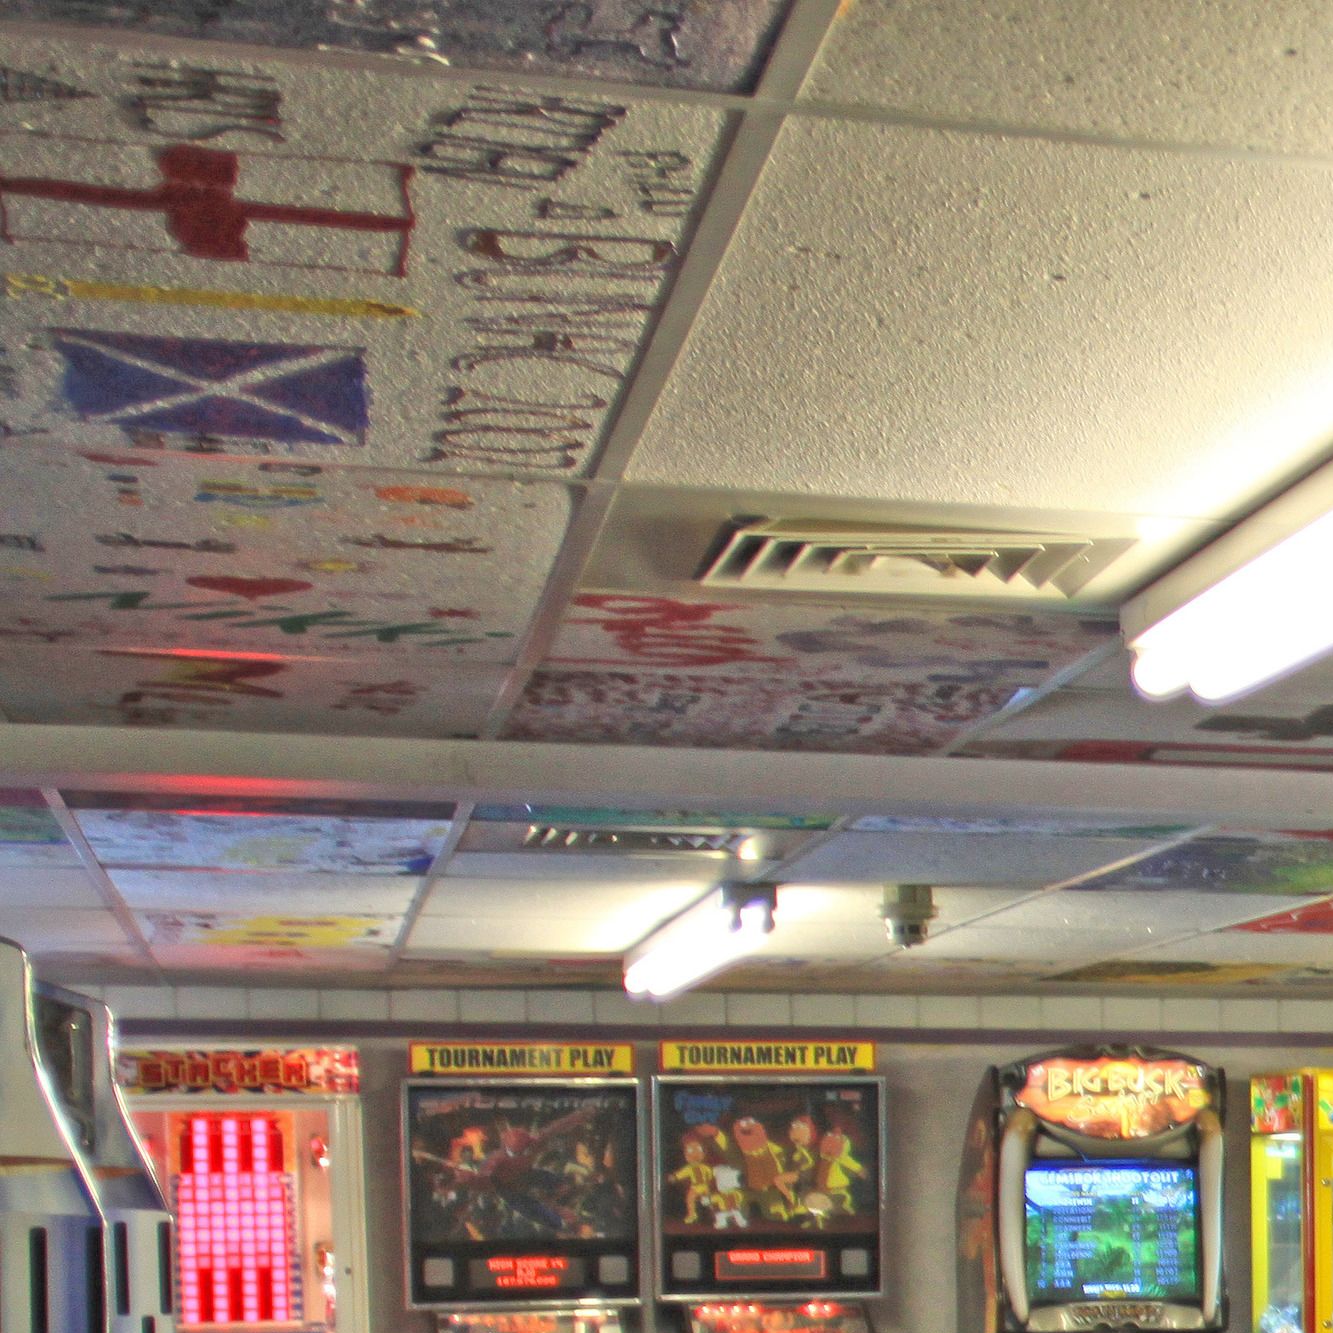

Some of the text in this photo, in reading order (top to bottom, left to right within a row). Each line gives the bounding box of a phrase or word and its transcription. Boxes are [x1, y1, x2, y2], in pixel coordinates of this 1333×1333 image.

[427, 1047, 616, 1067] TOURNAMENT PLAY
[676, 1046, 858, 1065] TOURNAMENT PLAY
[136, 1055, 310, 1086] STACKER
[1047, 1067, 1186, 1101] BIG BUCK
